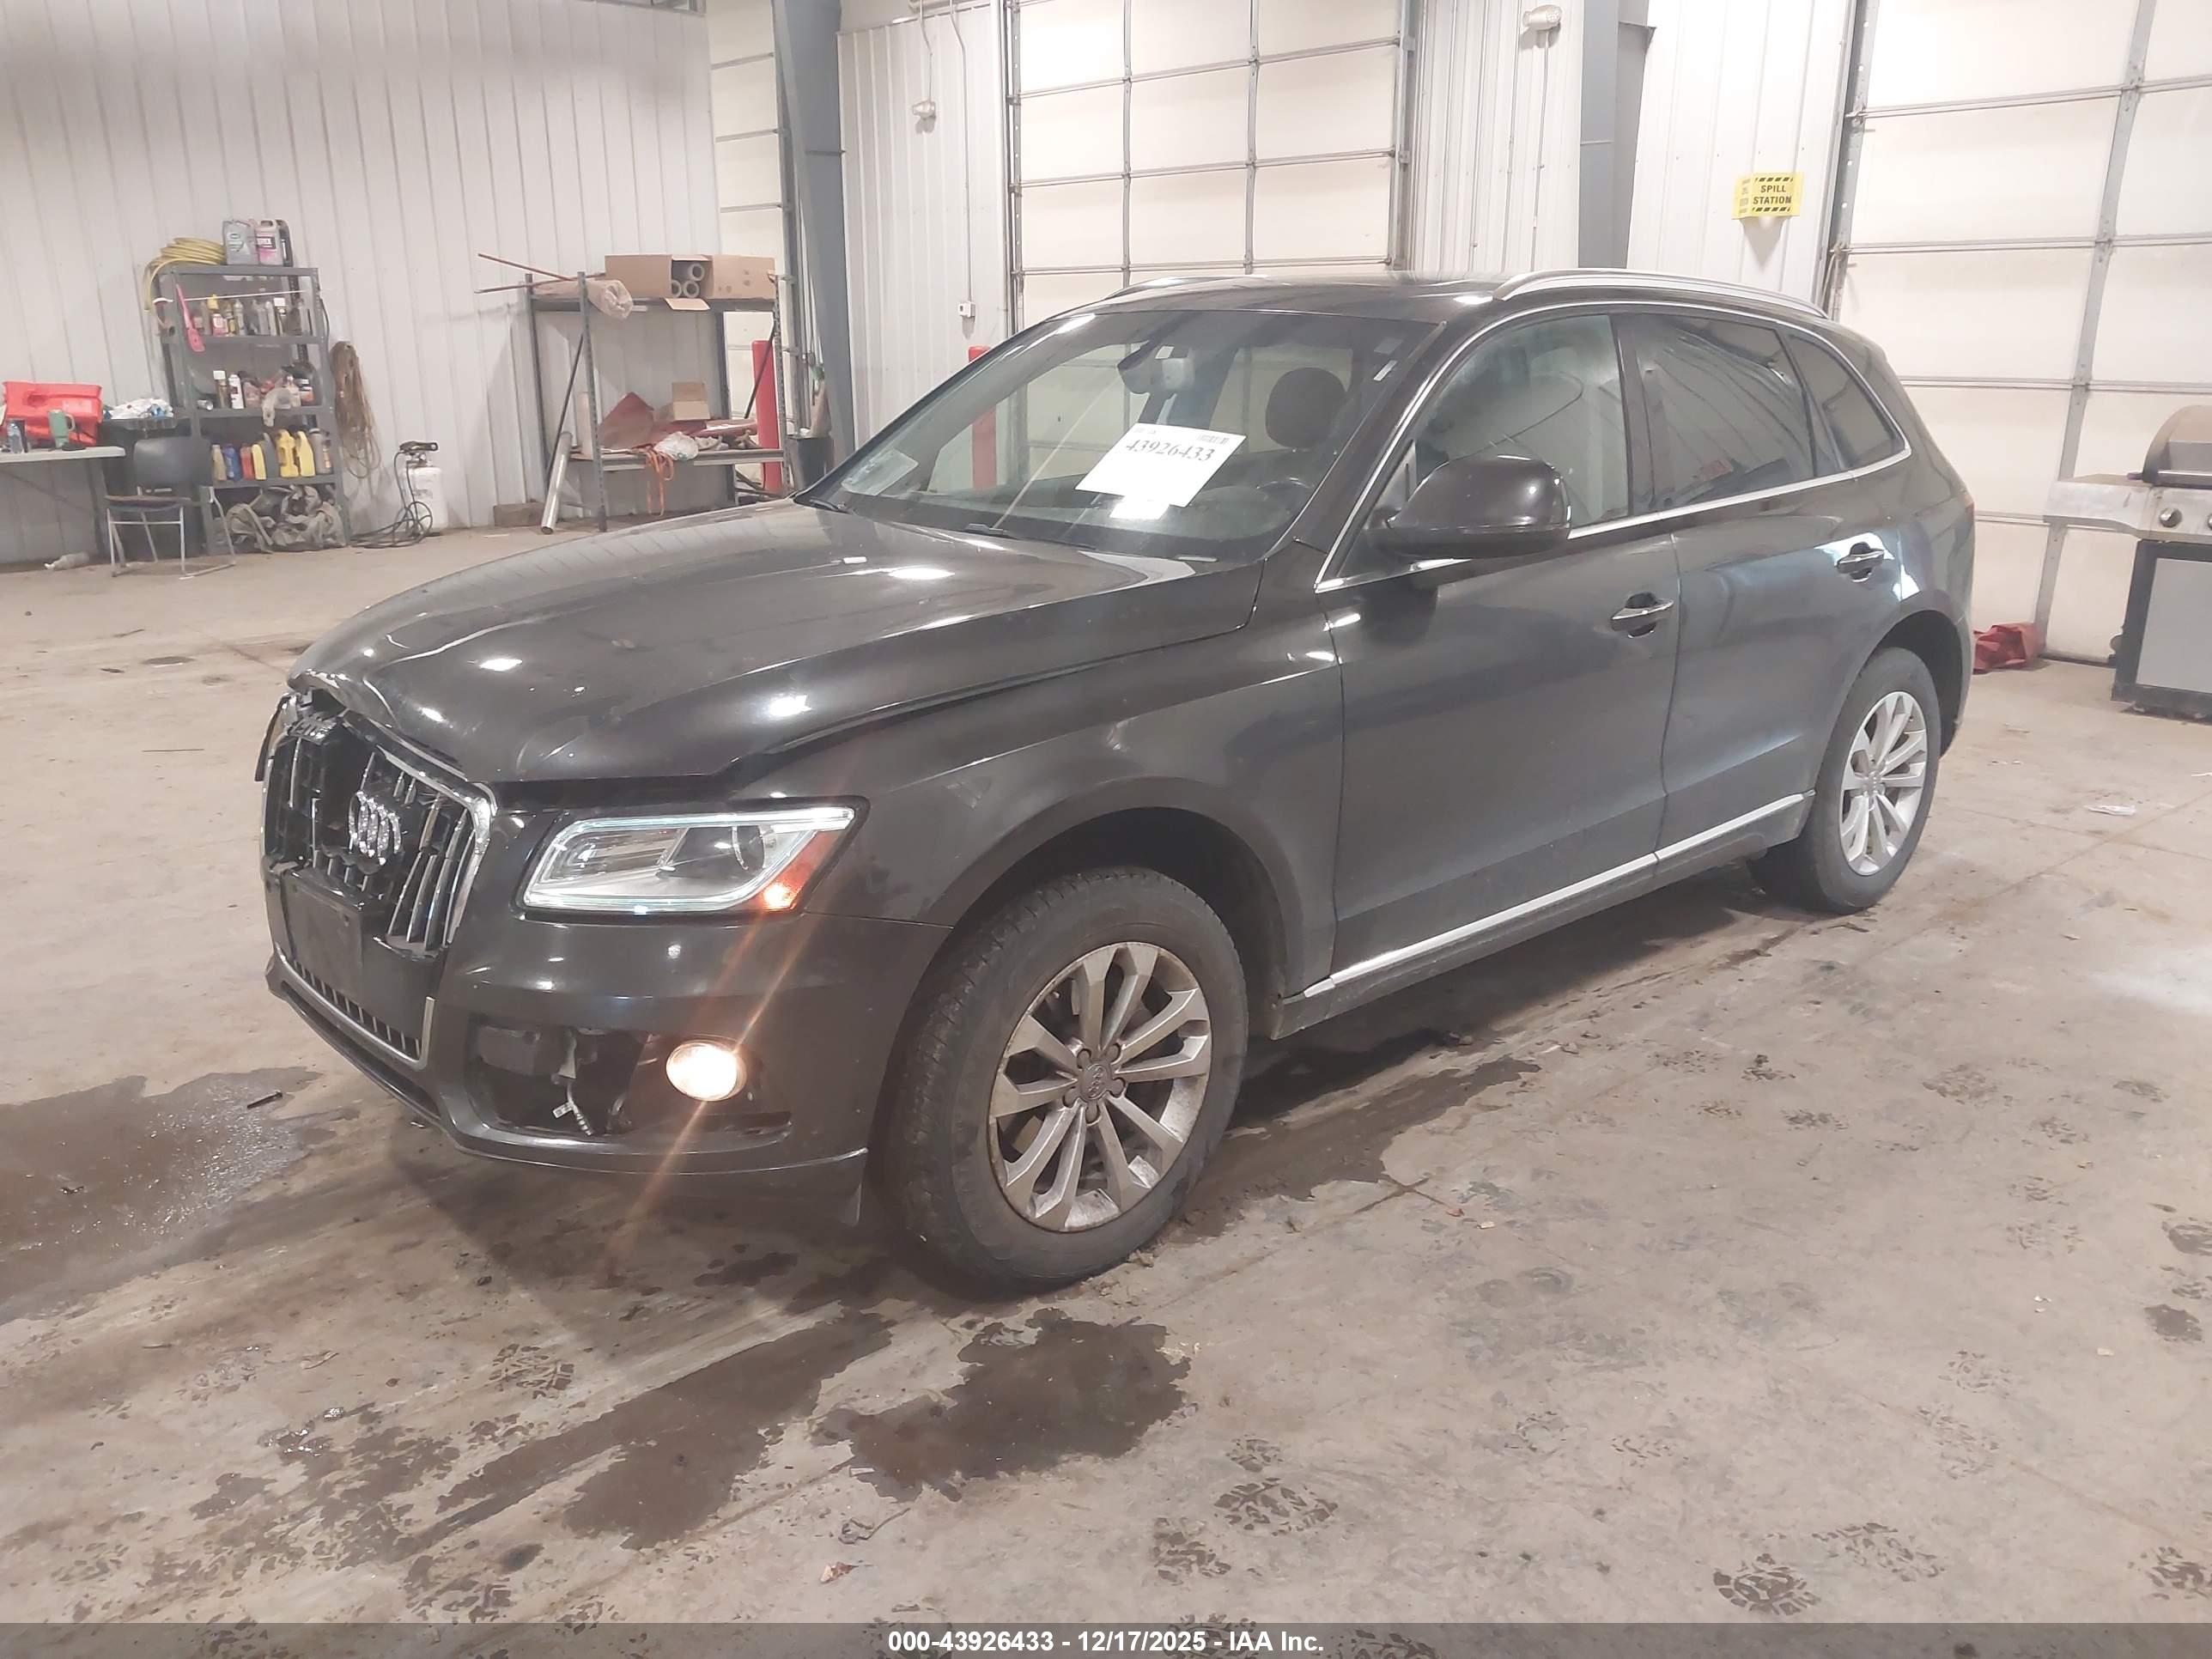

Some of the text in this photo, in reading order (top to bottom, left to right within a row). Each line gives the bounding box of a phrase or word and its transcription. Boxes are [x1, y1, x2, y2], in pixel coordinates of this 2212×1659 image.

[1760, 185, 1787, 193] SPILL
[1753, 196, 1792, 204] STATION
[1126, 439, 1216, 461] 43926433
